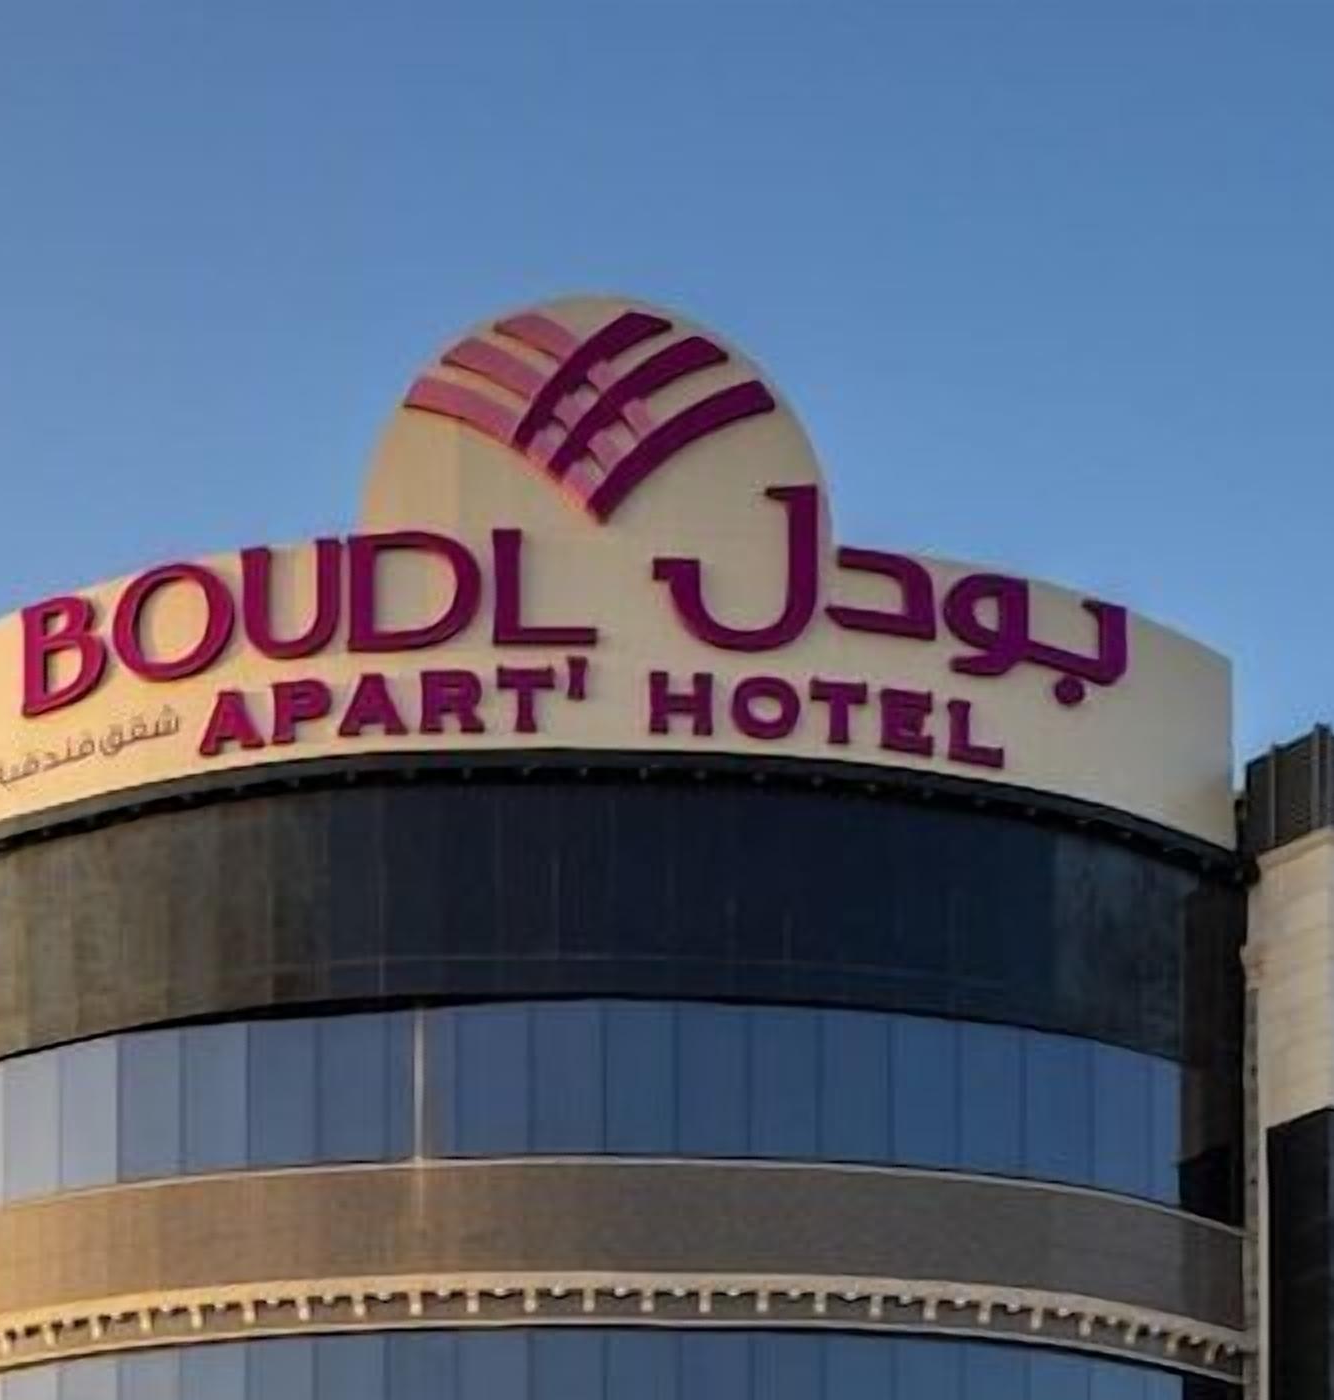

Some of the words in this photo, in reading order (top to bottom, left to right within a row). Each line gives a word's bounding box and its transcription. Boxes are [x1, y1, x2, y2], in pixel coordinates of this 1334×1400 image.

[20, 529, 597, 718] BOUDL
[652, 484, 1128, 706] بودل
[648, 669, 1005, 769] HOTEL
